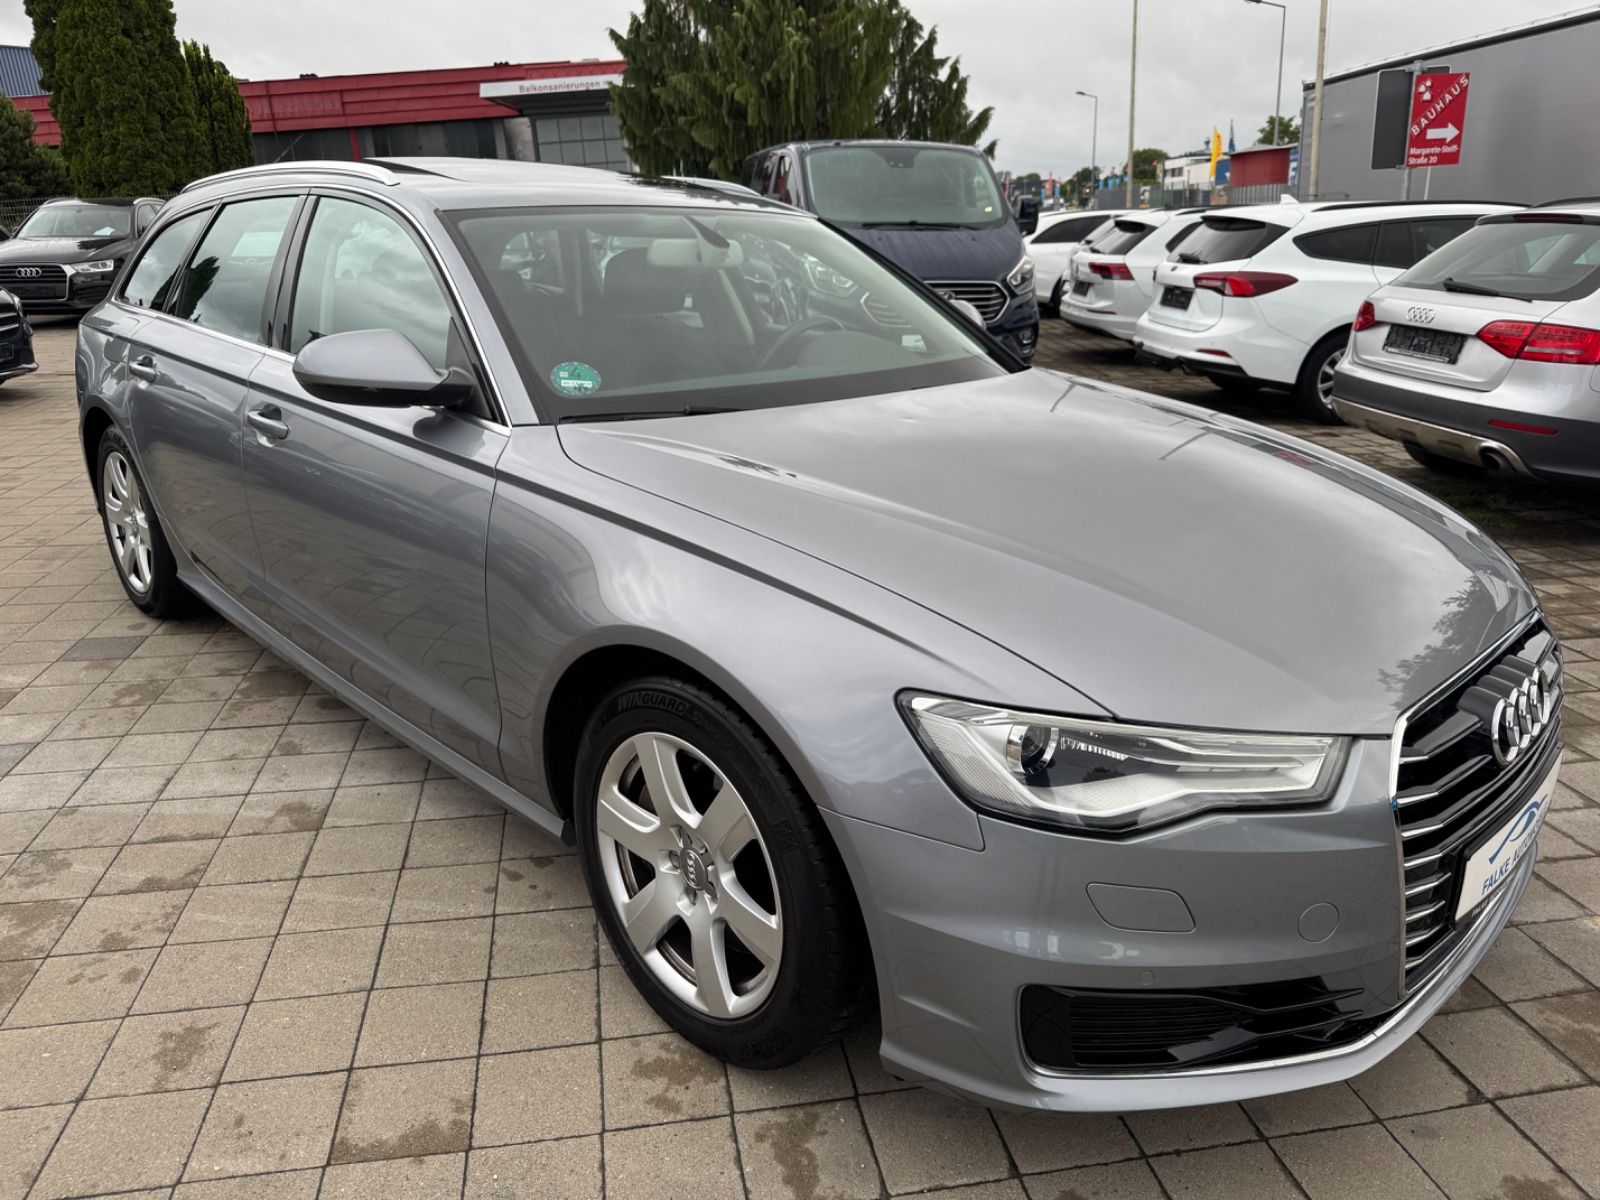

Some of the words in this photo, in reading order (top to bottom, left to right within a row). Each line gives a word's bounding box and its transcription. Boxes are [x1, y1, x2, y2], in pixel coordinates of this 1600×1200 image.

[519, 80, 600, 94] Balkonsanierungen
[1411, 75, 1469, 136] BAUHAUS
[1408, 156, 1428, 165] Straße
[1428, 156, 1437, 164] 20
[1482, 857, 1511, 896] FALKE
